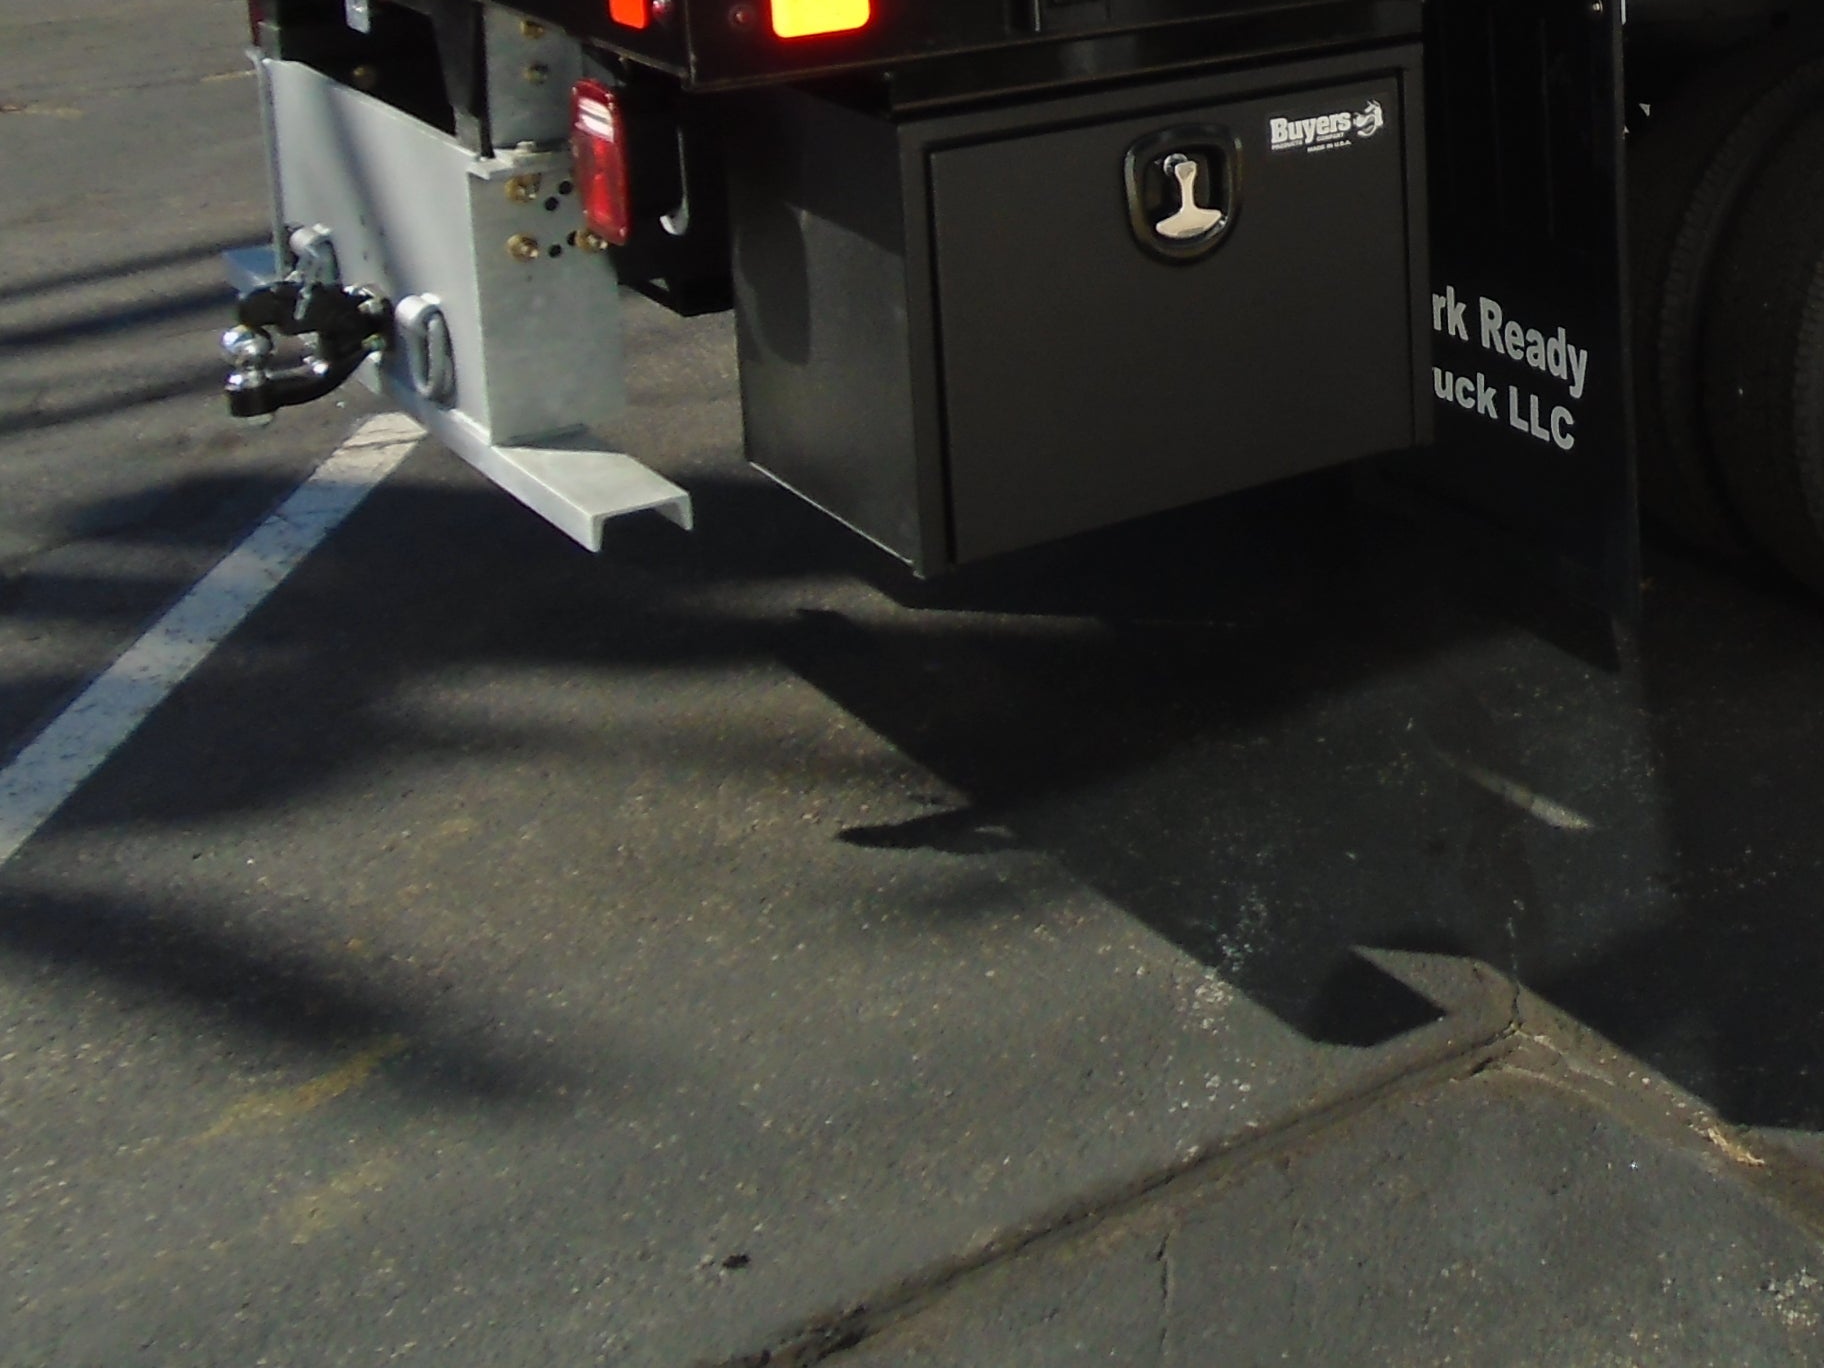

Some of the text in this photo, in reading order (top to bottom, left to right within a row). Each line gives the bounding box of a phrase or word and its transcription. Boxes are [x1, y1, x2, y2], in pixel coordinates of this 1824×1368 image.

[1270, 112, 1351, 144] Buyers
[1479, 296, 1588, 399] Ready
[1432, 366, 1575, 450] uck LLC
